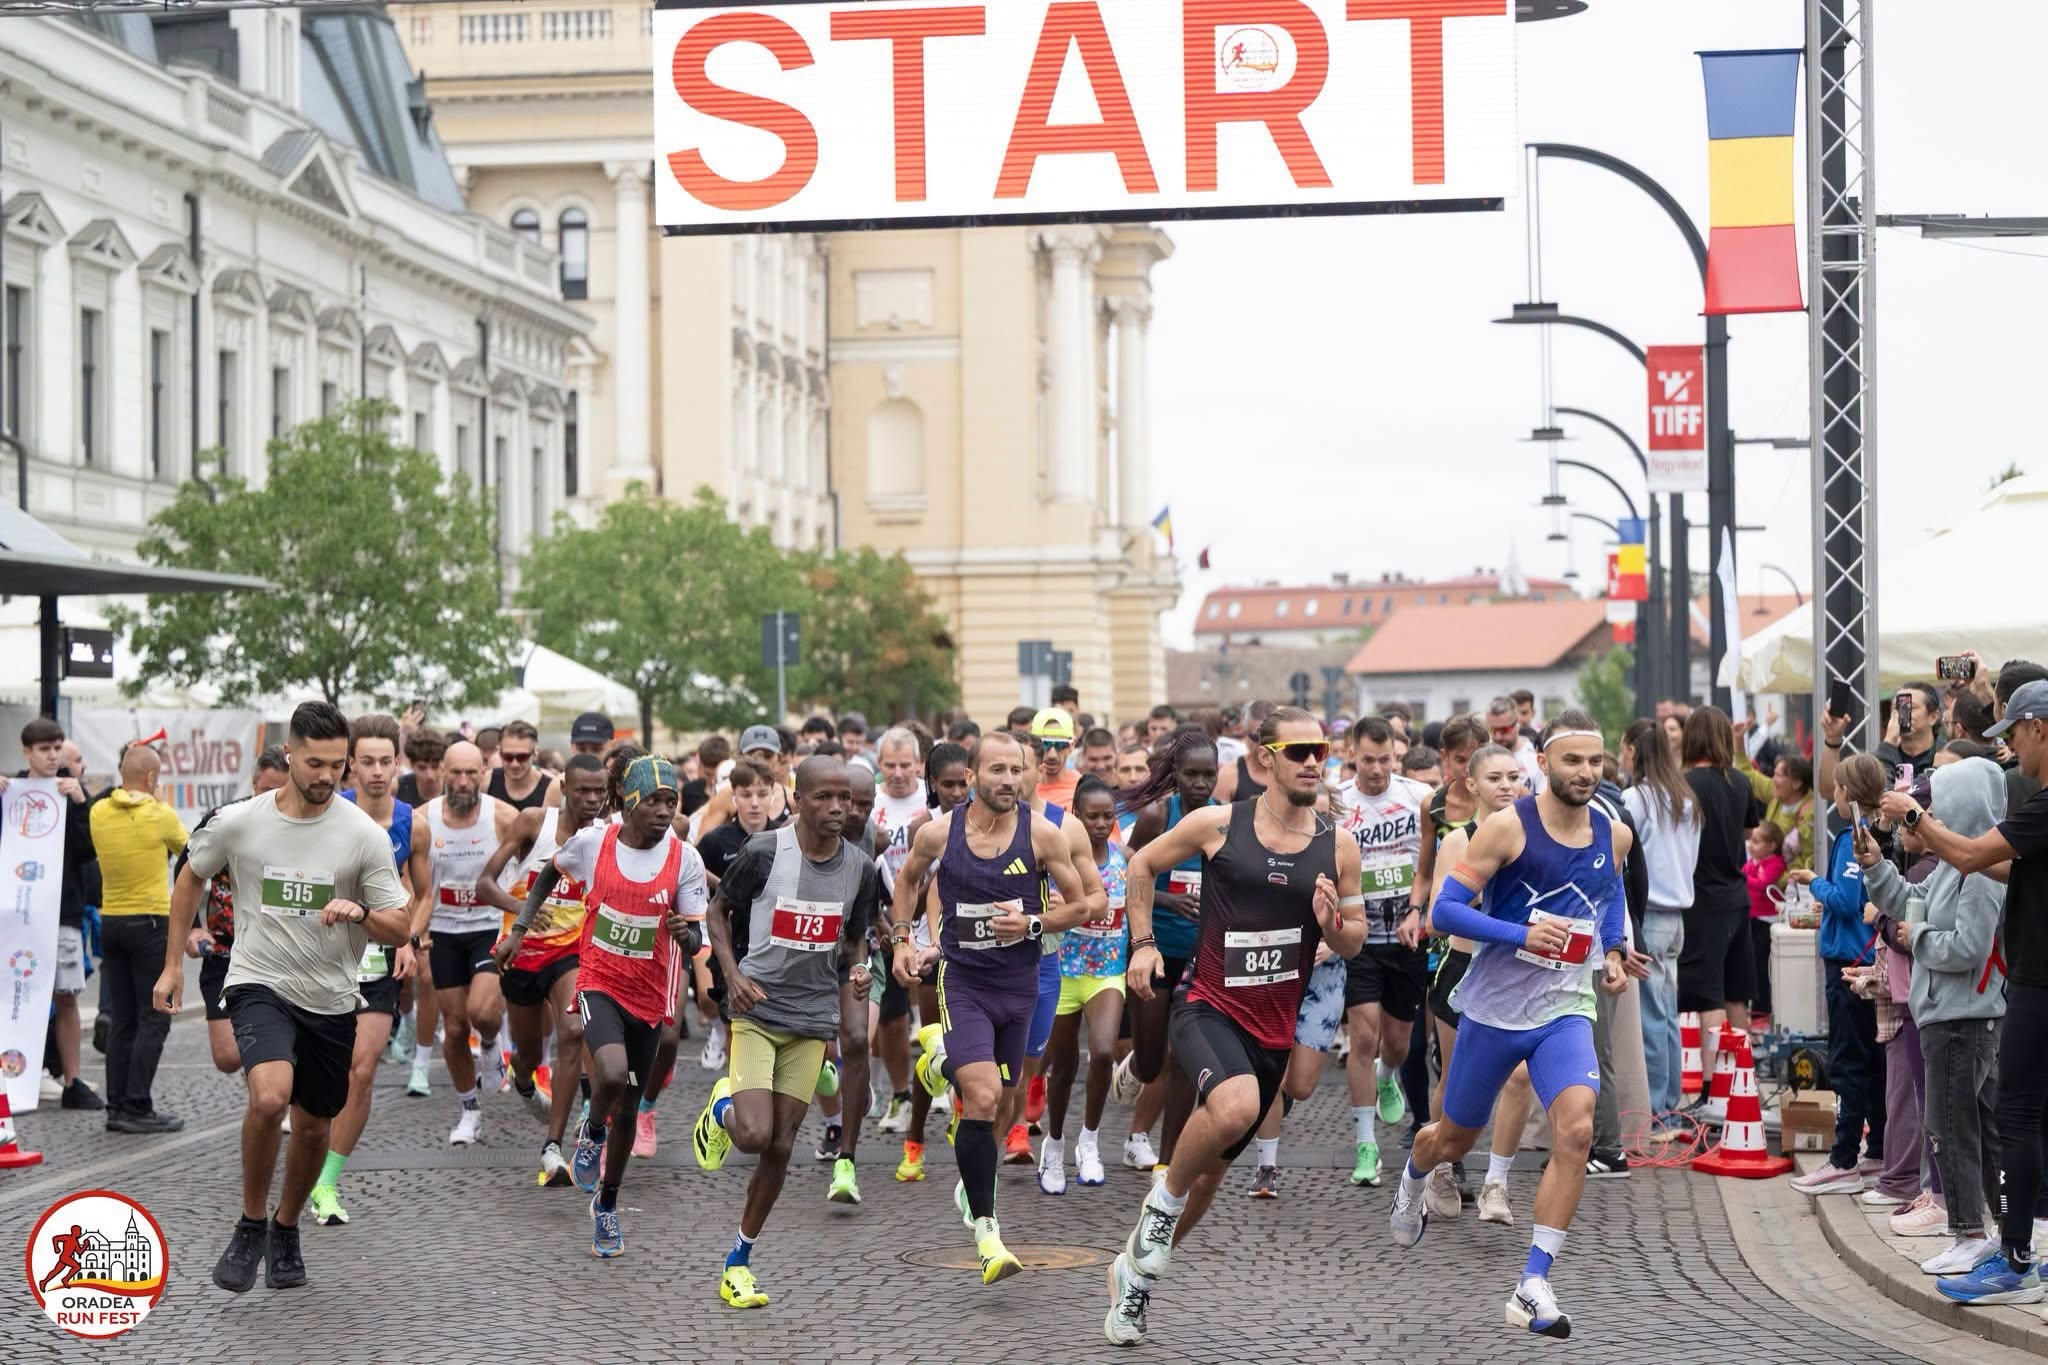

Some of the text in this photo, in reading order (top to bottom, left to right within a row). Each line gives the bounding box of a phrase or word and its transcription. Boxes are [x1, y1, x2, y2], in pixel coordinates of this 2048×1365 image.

[667, 0, 1507, 211] START
[1651, 405, 1702, 436] TIFF
[1374, 867, 1403, 886] 596
[282, 881, 313, 903] 515
[453, 890, 476, 903] 152
[609, 923, 640, 944] 570
[794, 915, 824, 936] 173
[975, 920, 996, 938] 83
[1245, 949, 1282, 972] 842
